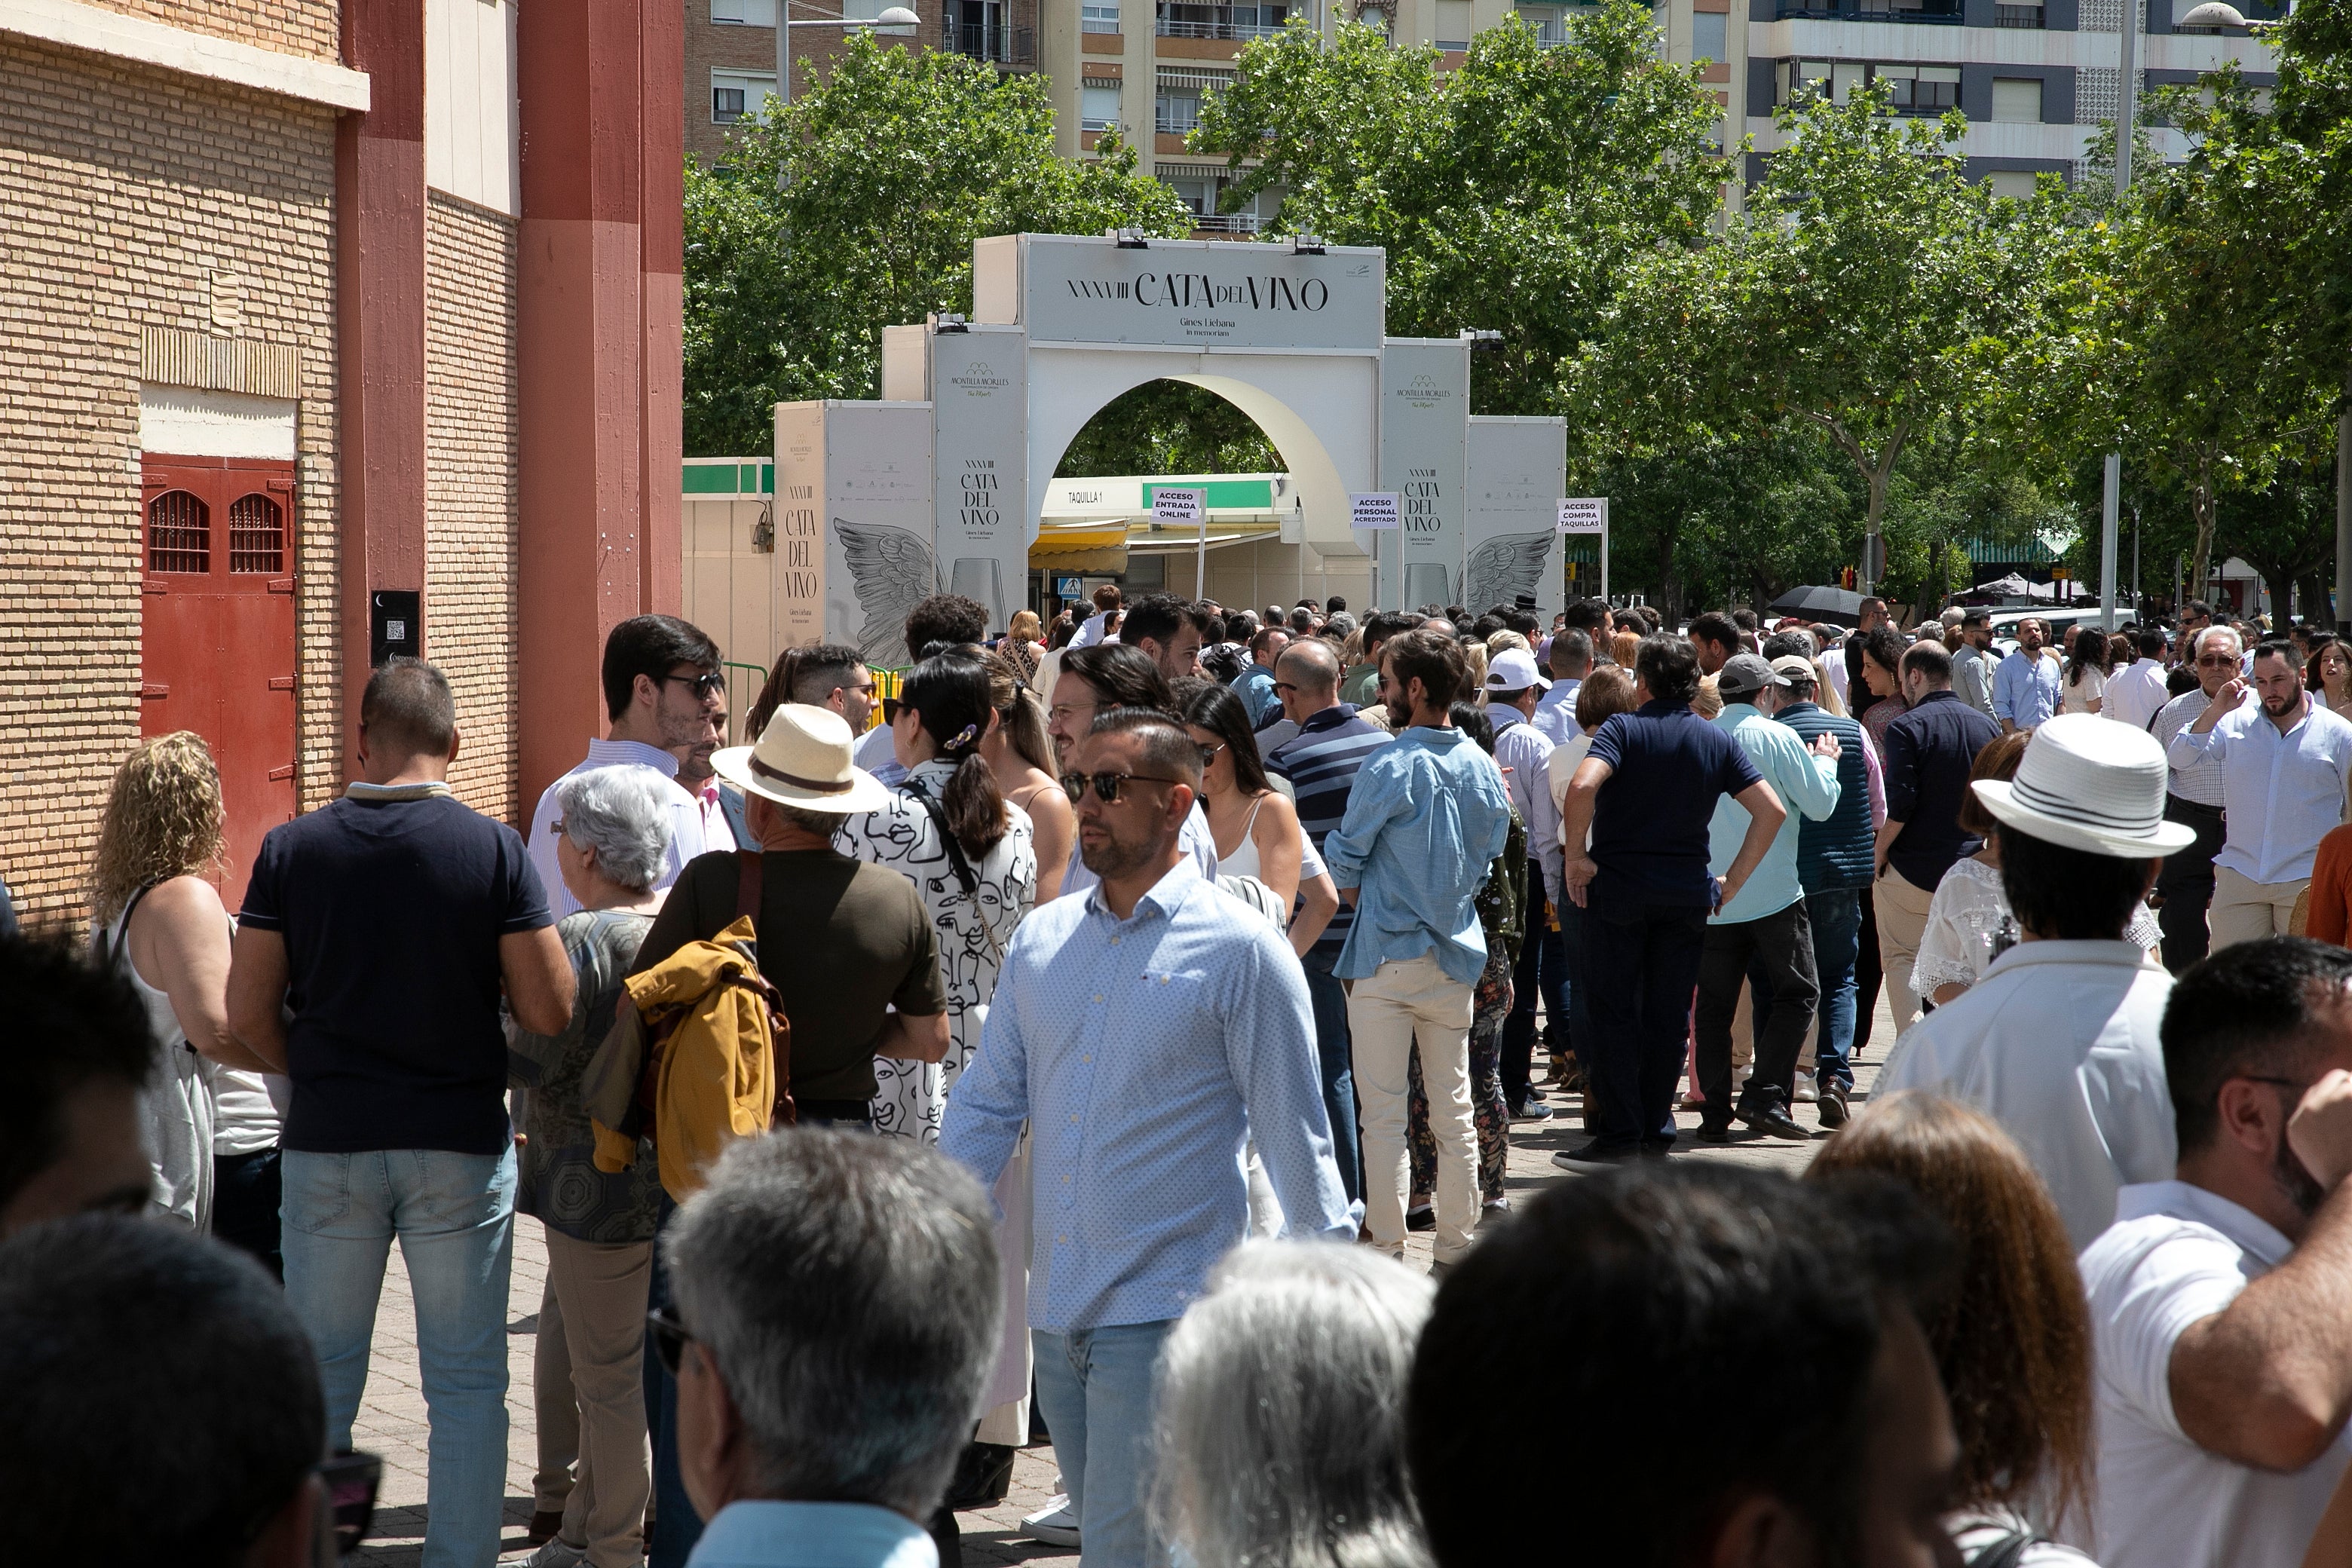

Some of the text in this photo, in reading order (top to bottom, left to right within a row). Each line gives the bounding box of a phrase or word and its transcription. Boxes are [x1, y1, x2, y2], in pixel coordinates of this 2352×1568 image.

[1067, 272, 1329, 311] XXXVIII CATA DEL VINO
[951, 377, 980, 385] MONTILLA
[960, 473, 998, 489] CATA
[1068, 491, 1102, 504] TAQUILLA 1
[1159, 492, 1193, 501] ACCESO
[1404, 482, 1440, 498] CATA
[965, 491, 995, 507] DEL
[1155, 501, 1196, 510] ENTRADA
[1408, 499, 1437, 515] DEL
[786, 509, 816, 536] CATA
[960, 509, 1000, 525] VINO
[1159, 510, 1191, 519] ONLINE
[1404, 516, 1441, 531] VINO
[789, 541, 813, 567] DEL
[786, 571, 817, 599] VINO
